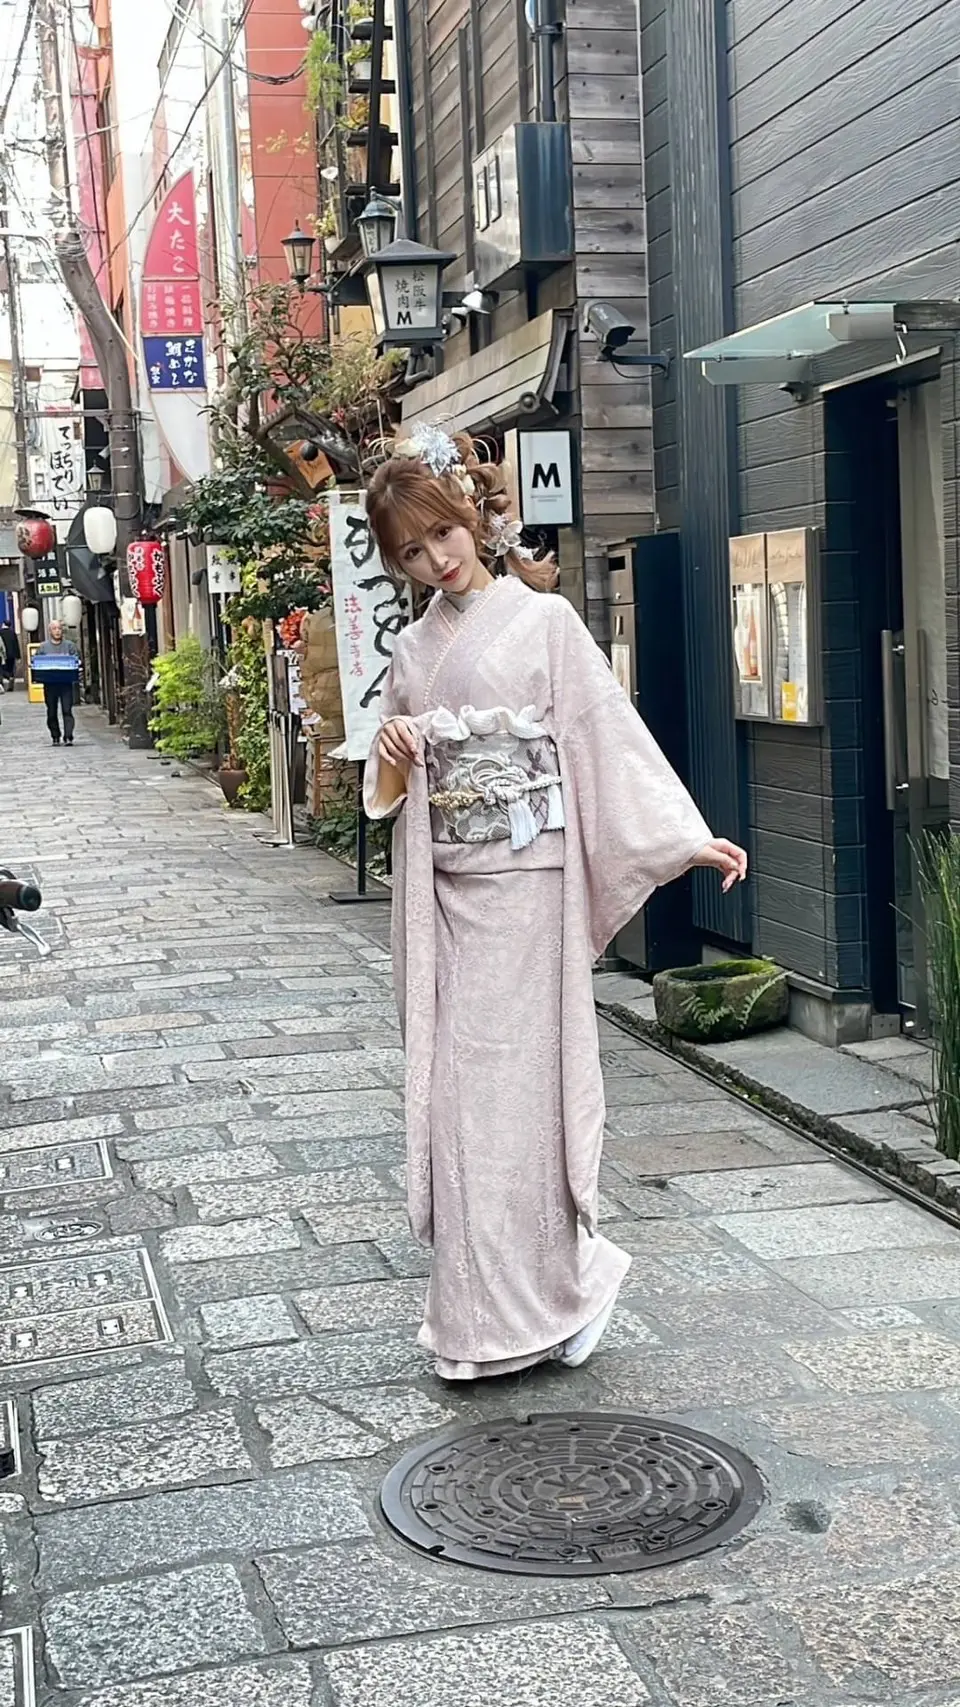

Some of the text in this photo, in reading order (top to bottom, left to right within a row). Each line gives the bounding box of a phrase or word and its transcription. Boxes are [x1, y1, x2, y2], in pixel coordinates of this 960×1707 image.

[166, 201, 191, 273] 大たこ
[395, 278, 410, 309] 焼肉
[412, 269, 427, 312] 松阪牛
[396, 311, 412, 326] M
[183, 339, 198, 384] さかな
[58, 426, 74, 485] てっちり
[532, 463, 561, 489] M
[50, 450, 69, 511] ほてい
